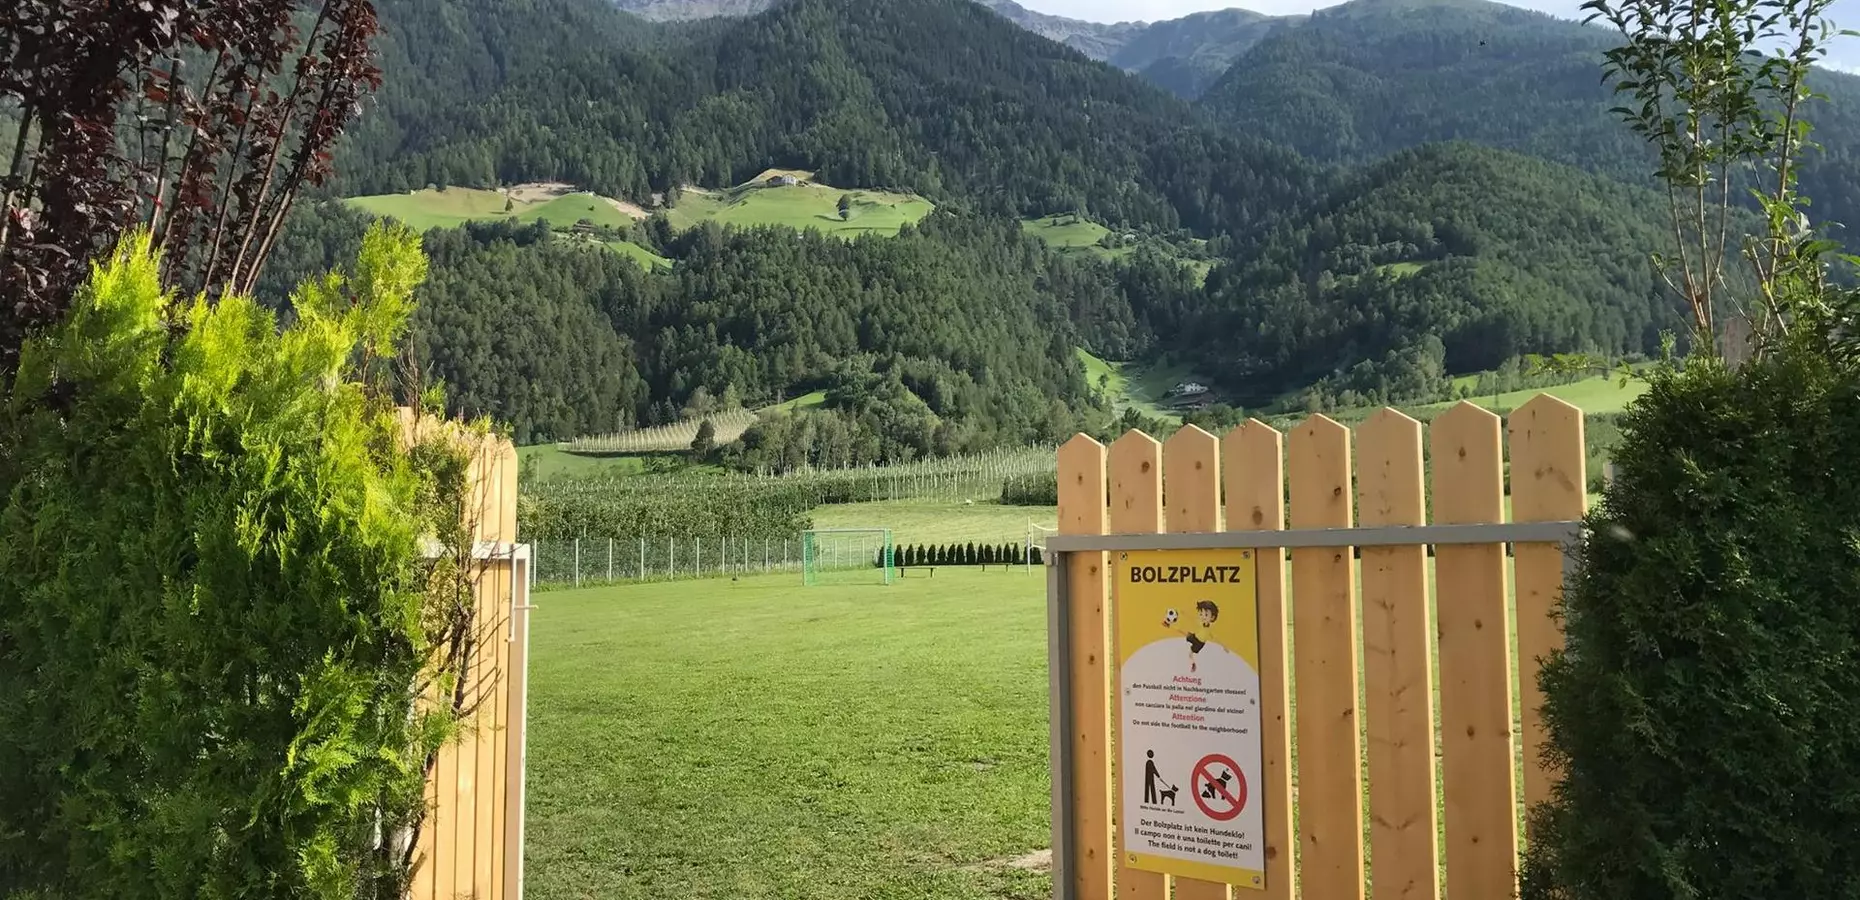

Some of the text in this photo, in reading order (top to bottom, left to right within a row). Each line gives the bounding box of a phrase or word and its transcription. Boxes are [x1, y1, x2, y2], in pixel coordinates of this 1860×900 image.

[1130, 566, 1240, 583] BOLZPLATZ
[1173, 675, 1202, 685] Achtung
[1169, 694, 1206, 703] Attenzione
[1172, 713, 1205, 721] Attention
[1171, 722, 1191, 730] football
[1208, 726, 1248, 734] neighborhood!
[1140, 818, 1245, 839] Der Bolzplatz ist kein Hundeklo!
[1140, 829, 1162, 839] campo
[1196, 837, 1221, 846] toilette
[1222, 841, 1235, 849] per
[1235, 843, 1253, 851] cani!
[1147, 839, 1160, 848] The
[1161, 841, 1176, 850] field
[1184, 845, 1196, 853] not
[1203, 847, 1217, 858] dog
[1217, 850, 1239, 860] toilet!
